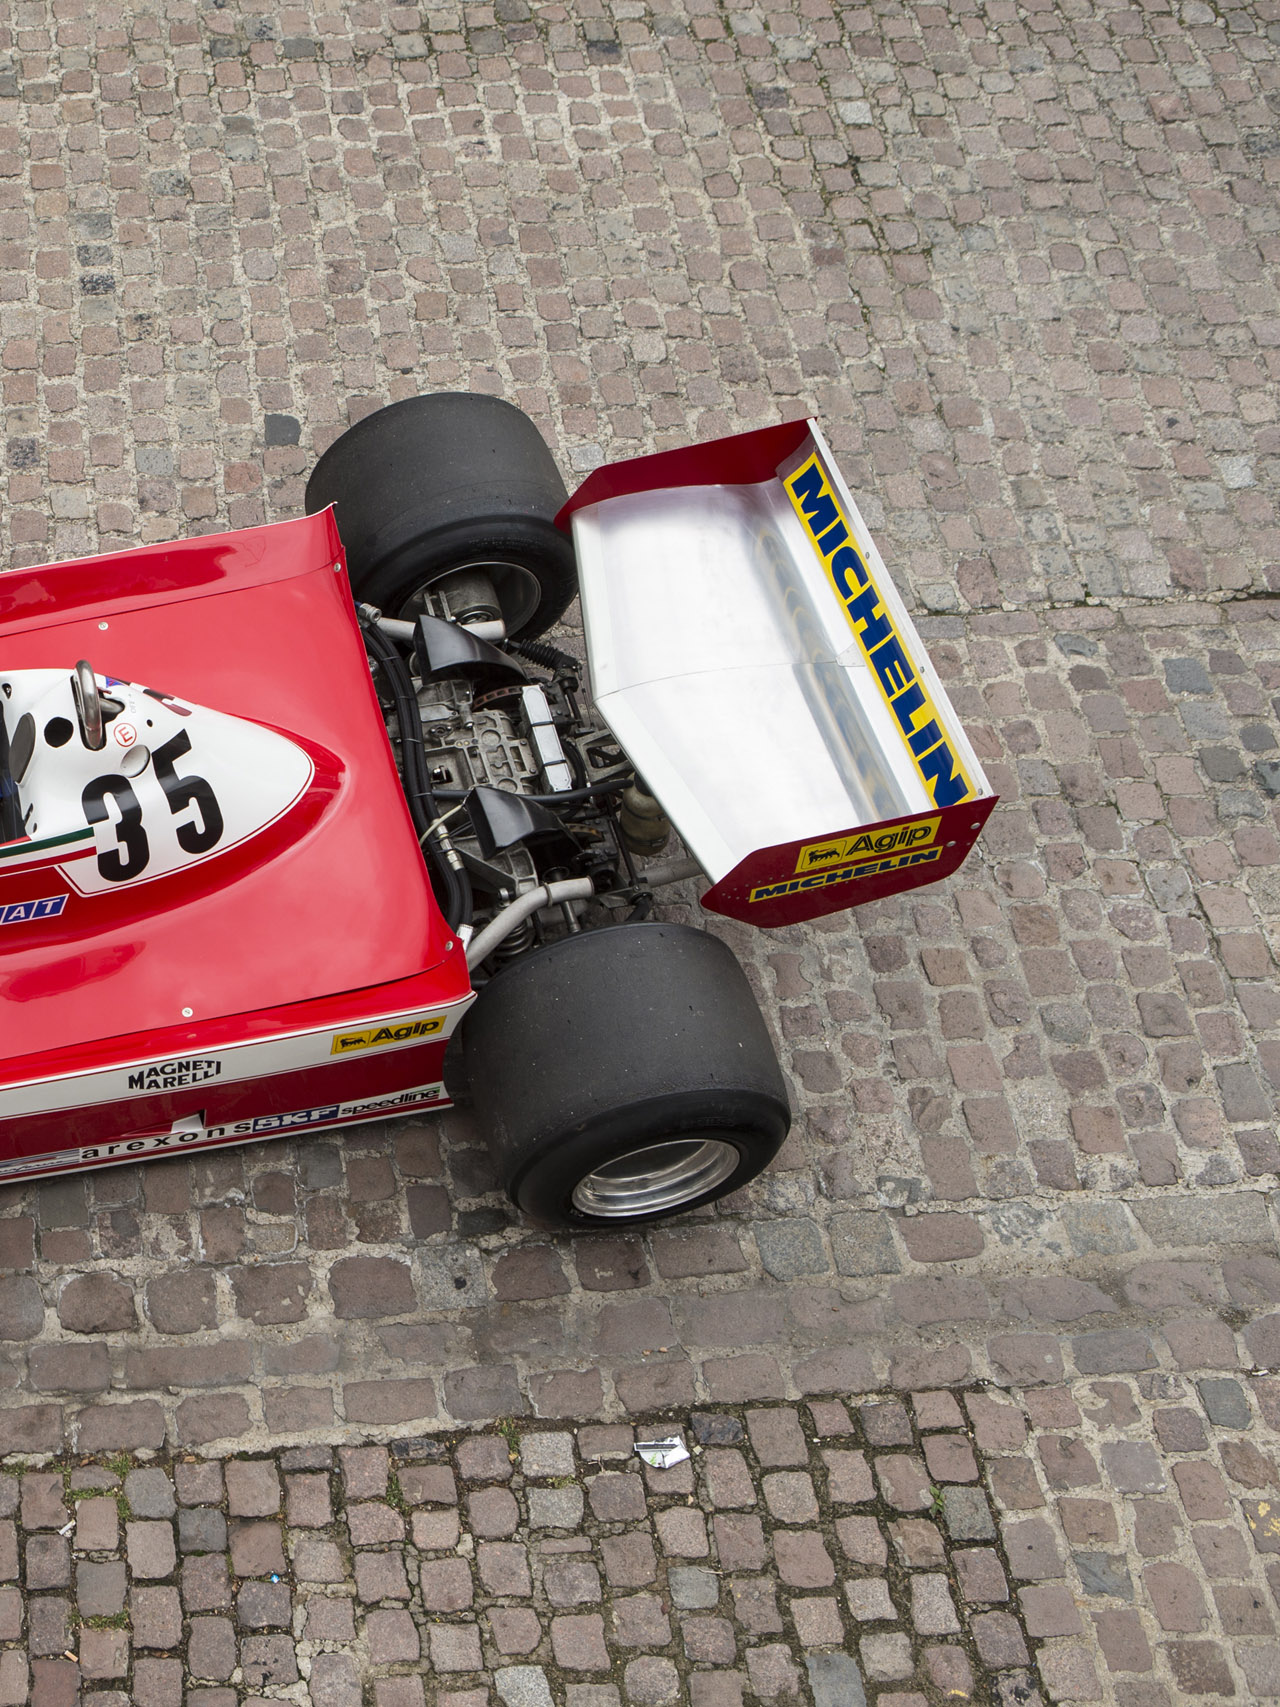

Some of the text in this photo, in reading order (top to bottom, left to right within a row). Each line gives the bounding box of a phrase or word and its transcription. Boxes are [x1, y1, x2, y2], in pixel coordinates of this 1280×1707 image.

[790, 463, 970, 808] MICHELIN
[118, 726, 133, 743] E
[82, 728, 224, 882] 35
[845, 825, 931, 856] Agip
[754, 849, 939, 899] MICHELIN
[371, 1021, 439, 1043] Agip
[128, 1060, 222, 1089] MAGNETI
[341, 1089, 438, 1115] speedline
[255, 1106, 338, 1132] SKF
[81, 1122, 251, 1160] arexons
